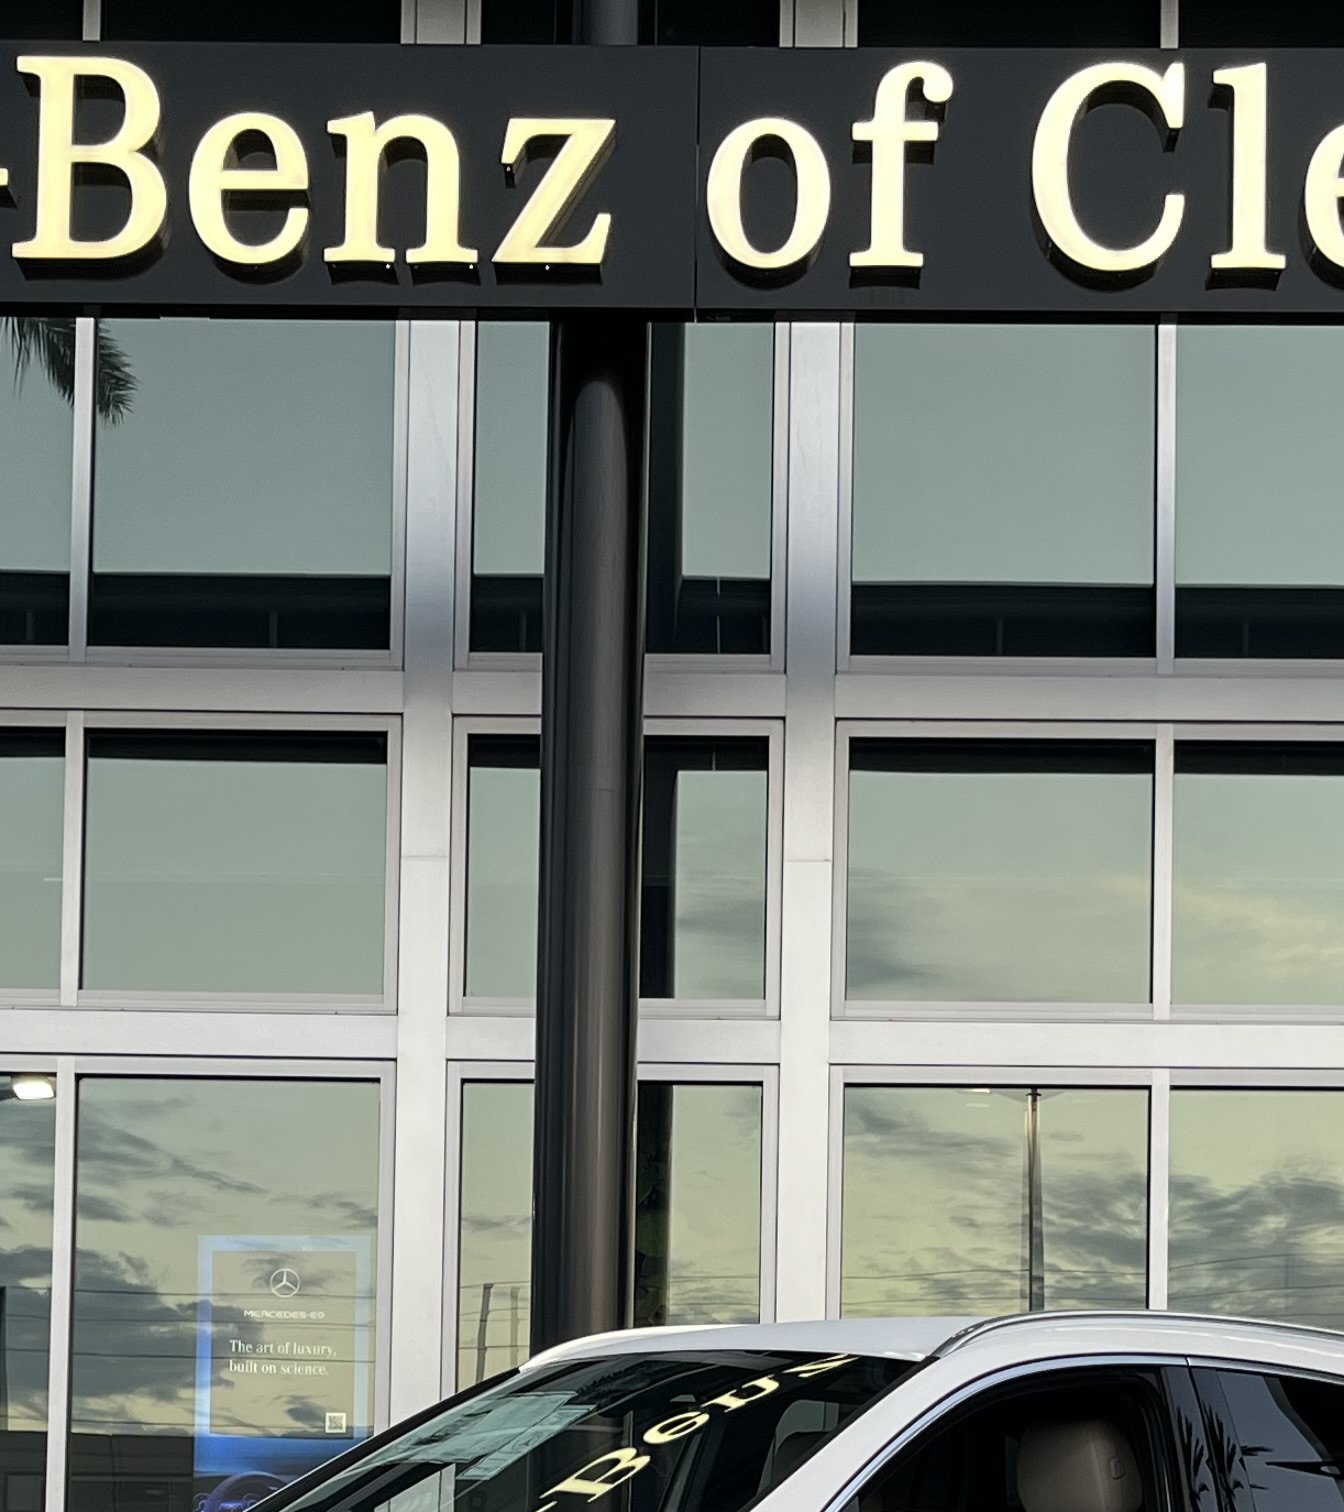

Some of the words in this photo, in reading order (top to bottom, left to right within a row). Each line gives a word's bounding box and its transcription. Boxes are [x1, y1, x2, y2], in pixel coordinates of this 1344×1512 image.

[707, 63, 953, 268] of
[229, 1339, 253, 1353] The
[255, 1343, 274, 1354] art
[277, 1341, 291, 1355] of
[293, 1341, 337, 1359] luxury,
[229, 1359, 258, 1373] built
[261, 1363, 277, 1374] on
